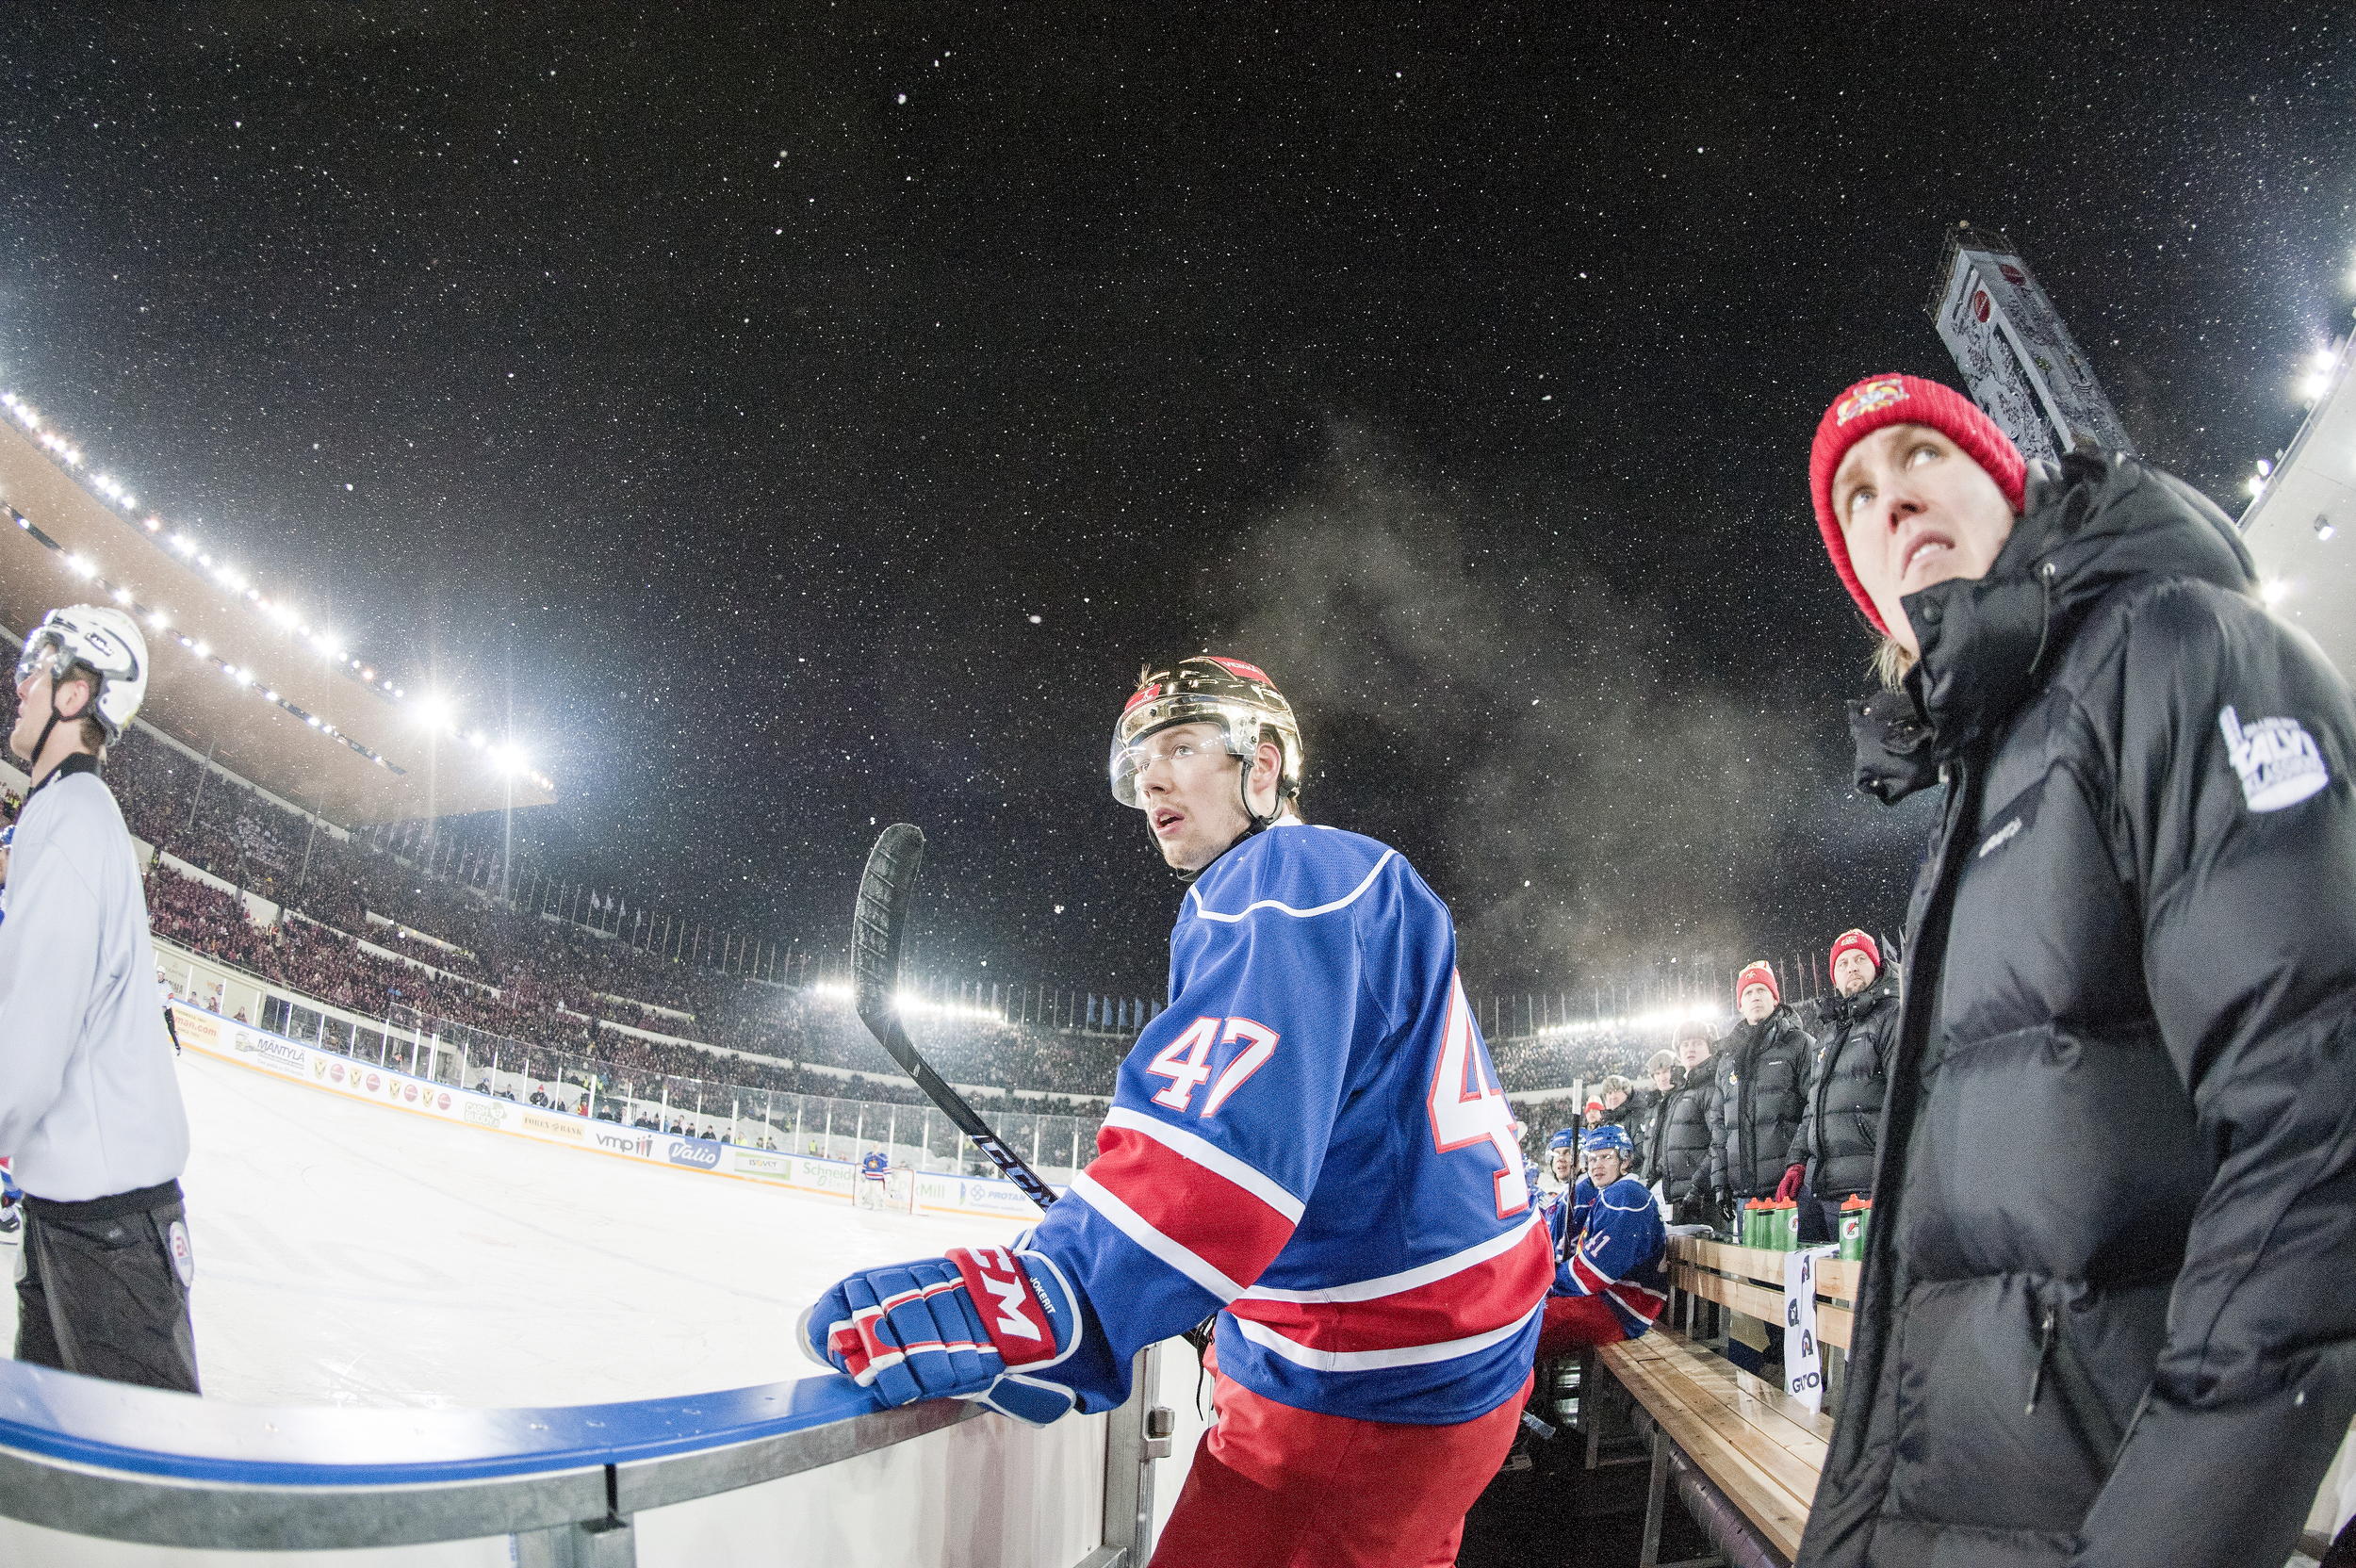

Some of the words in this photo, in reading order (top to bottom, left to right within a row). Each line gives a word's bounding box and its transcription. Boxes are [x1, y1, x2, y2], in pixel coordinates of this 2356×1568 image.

[2231, 729, 2321, 776] TALVI
[257, 1038, 305, 1062] MÄNTYLÄ
[1146, 1016, 1280, 1119] 47
[466, 1102, 489, 1115] CASH
[524, 1117, 549, 1129] FOREX
[560, 1123, 582, 1135] BANK
[596, 1134, 634, 1152] vmp
[672, 1144, 716, 1165] Valio
[988, 1190, 1026, 1202] PROTAN
[1842, 1217, 1859, 1241] G
[1584, 1229, 1612, 1259] 41
[1029, 1276, 1056, 1315] JOKERIT
